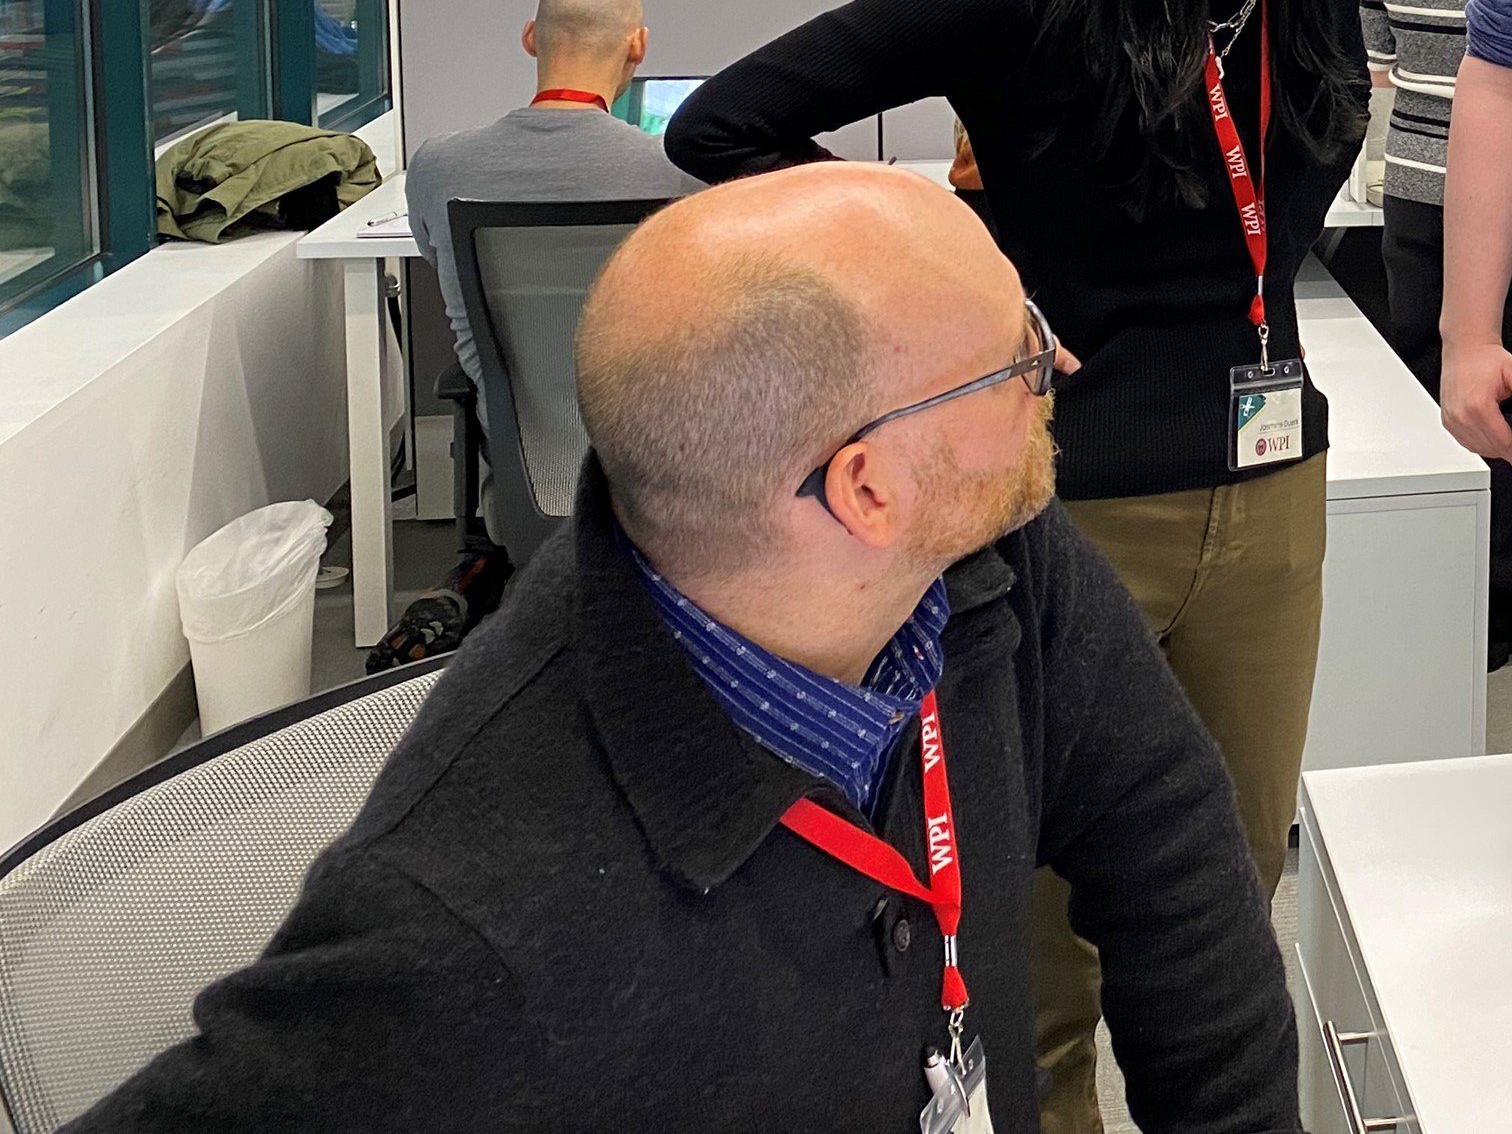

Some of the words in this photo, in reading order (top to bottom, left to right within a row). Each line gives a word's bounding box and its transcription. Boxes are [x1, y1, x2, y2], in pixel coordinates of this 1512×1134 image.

[1209, 83, 1228, 122] WPI
[1225, 145, 1248, 179] WPI
[1241, 202, 1262, 236] WPI
[1267, 434, 1290, 453] WPI
[921, 711, 942, 774] WPI
[928, 811, 953, 875] WPI
